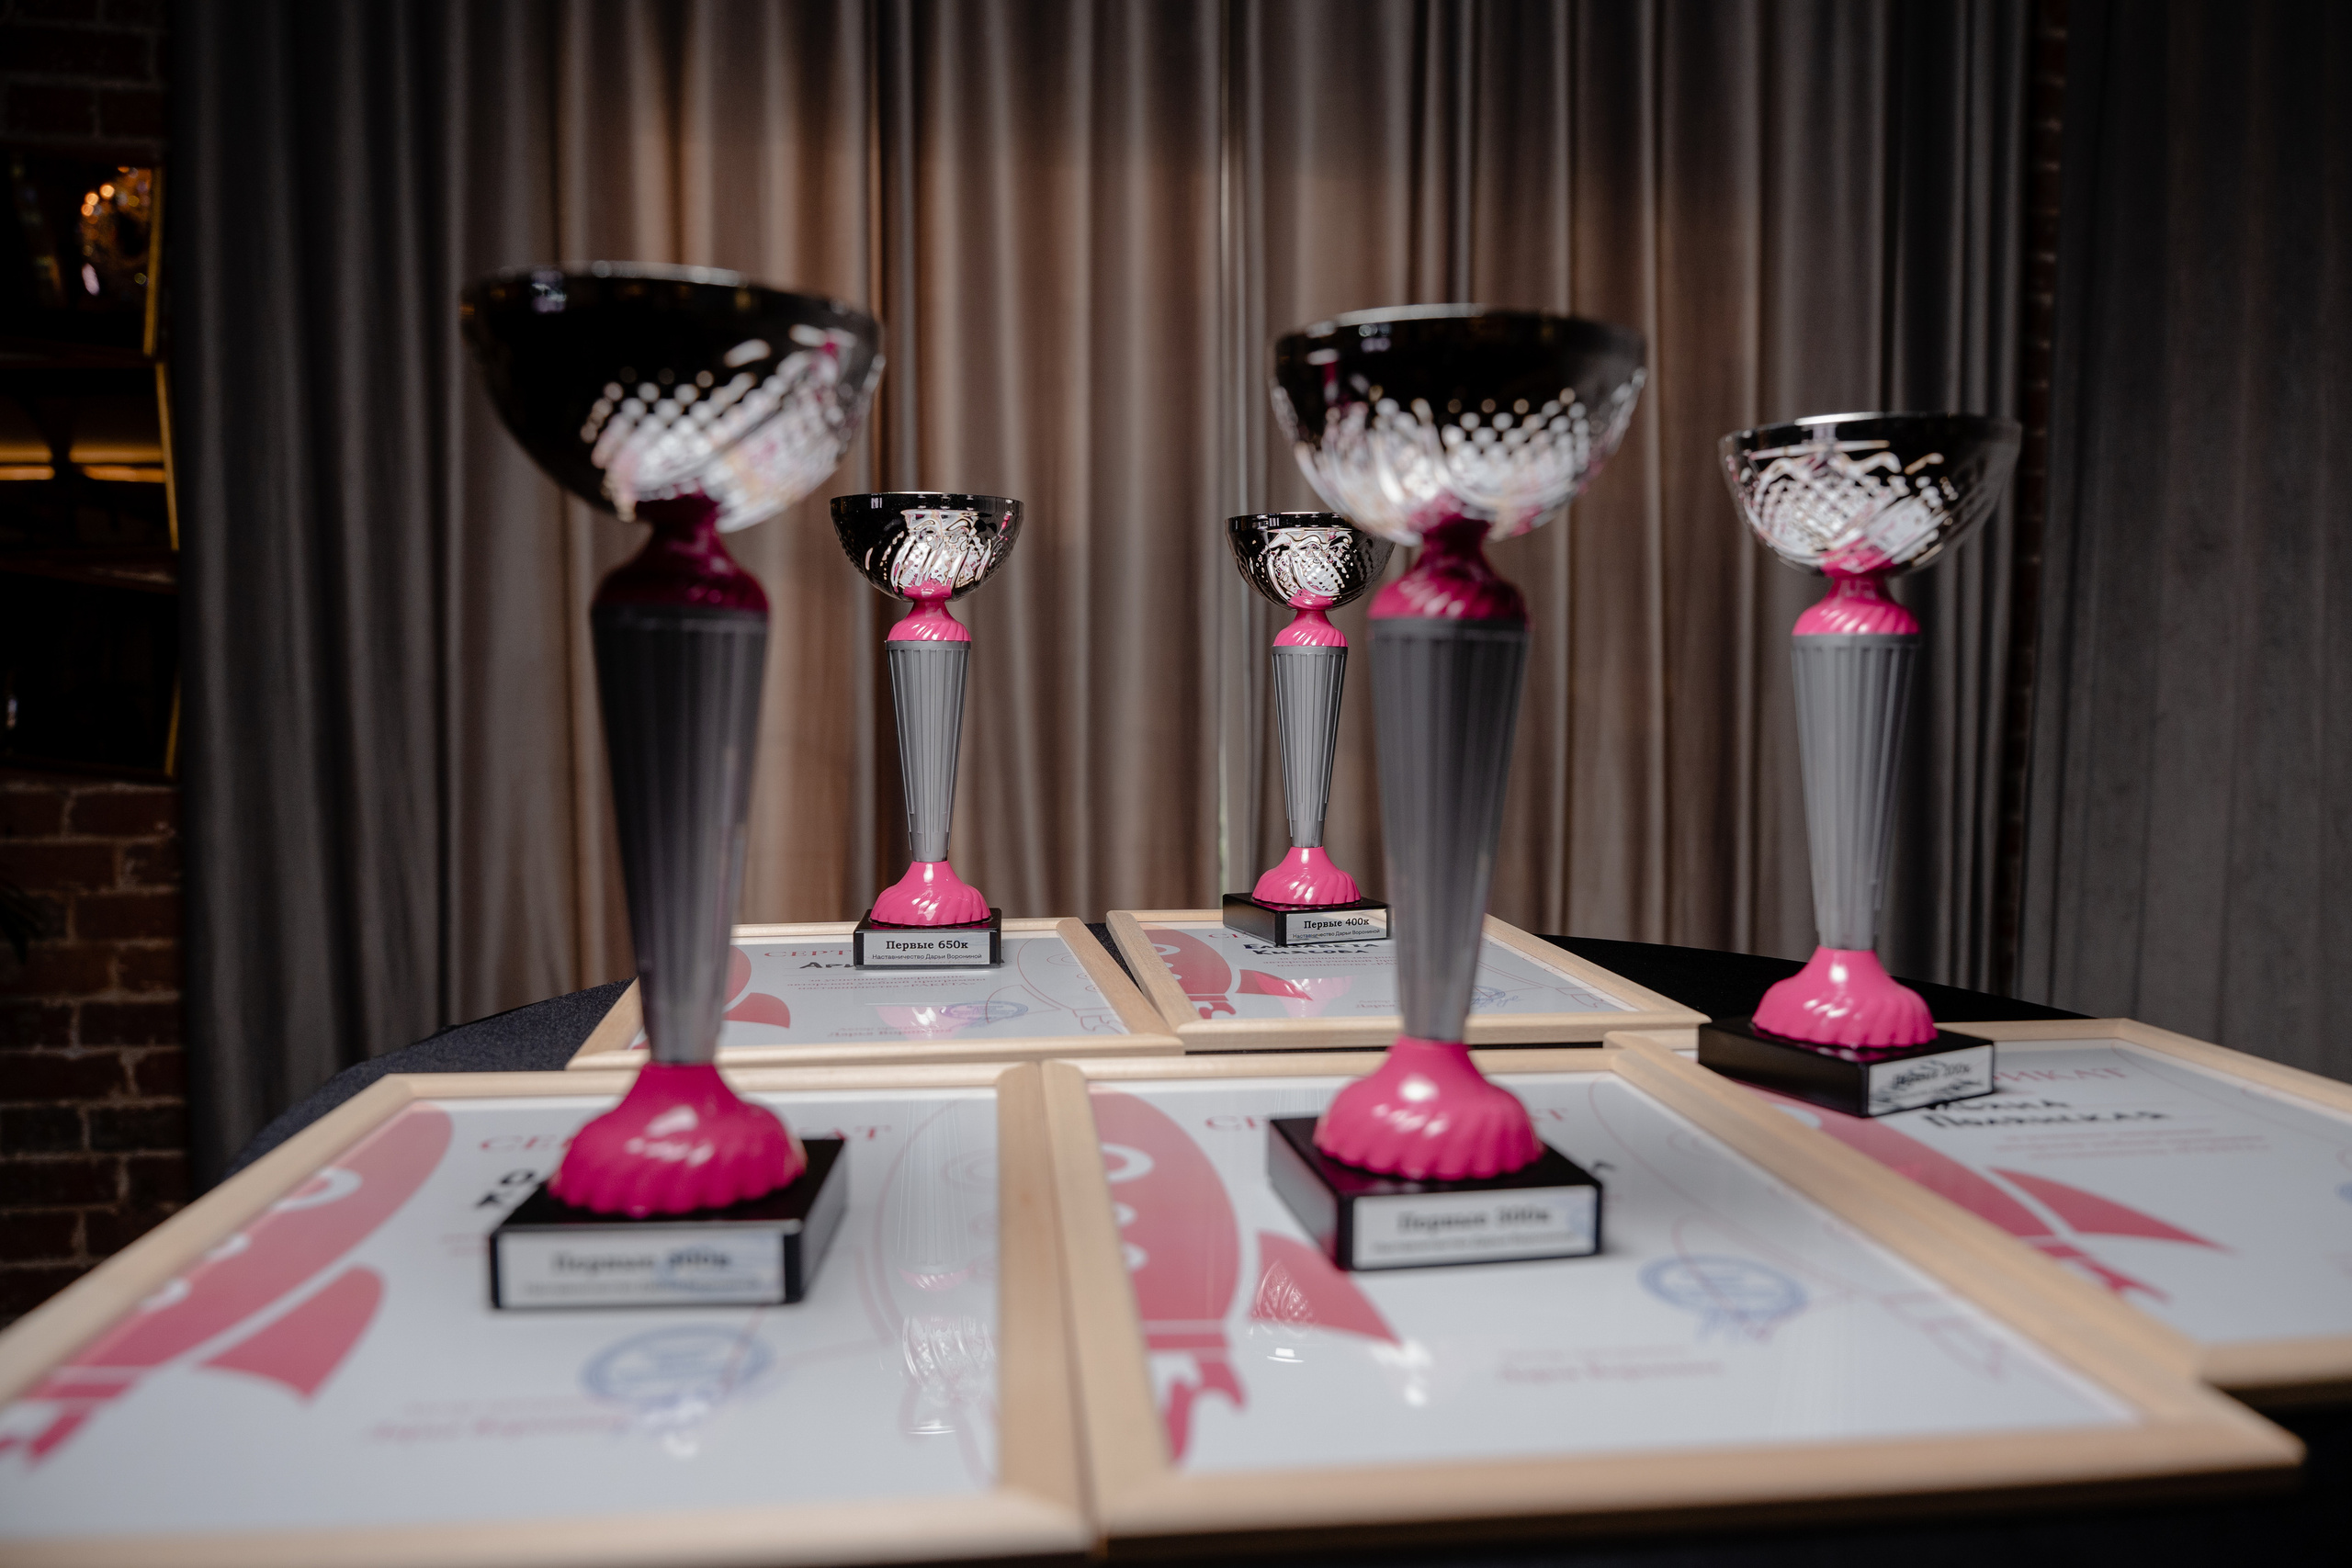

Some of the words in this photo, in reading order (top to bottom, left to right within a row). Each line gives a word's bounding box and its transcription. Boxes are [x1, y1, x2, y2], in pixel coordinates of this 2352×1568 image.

[1304, 920, 1342, 930] Первые
[1345, 918, 1370, 926] 400к
[886, 941, 934, 951] Первые
[938, 940, 968, 950] 650к
